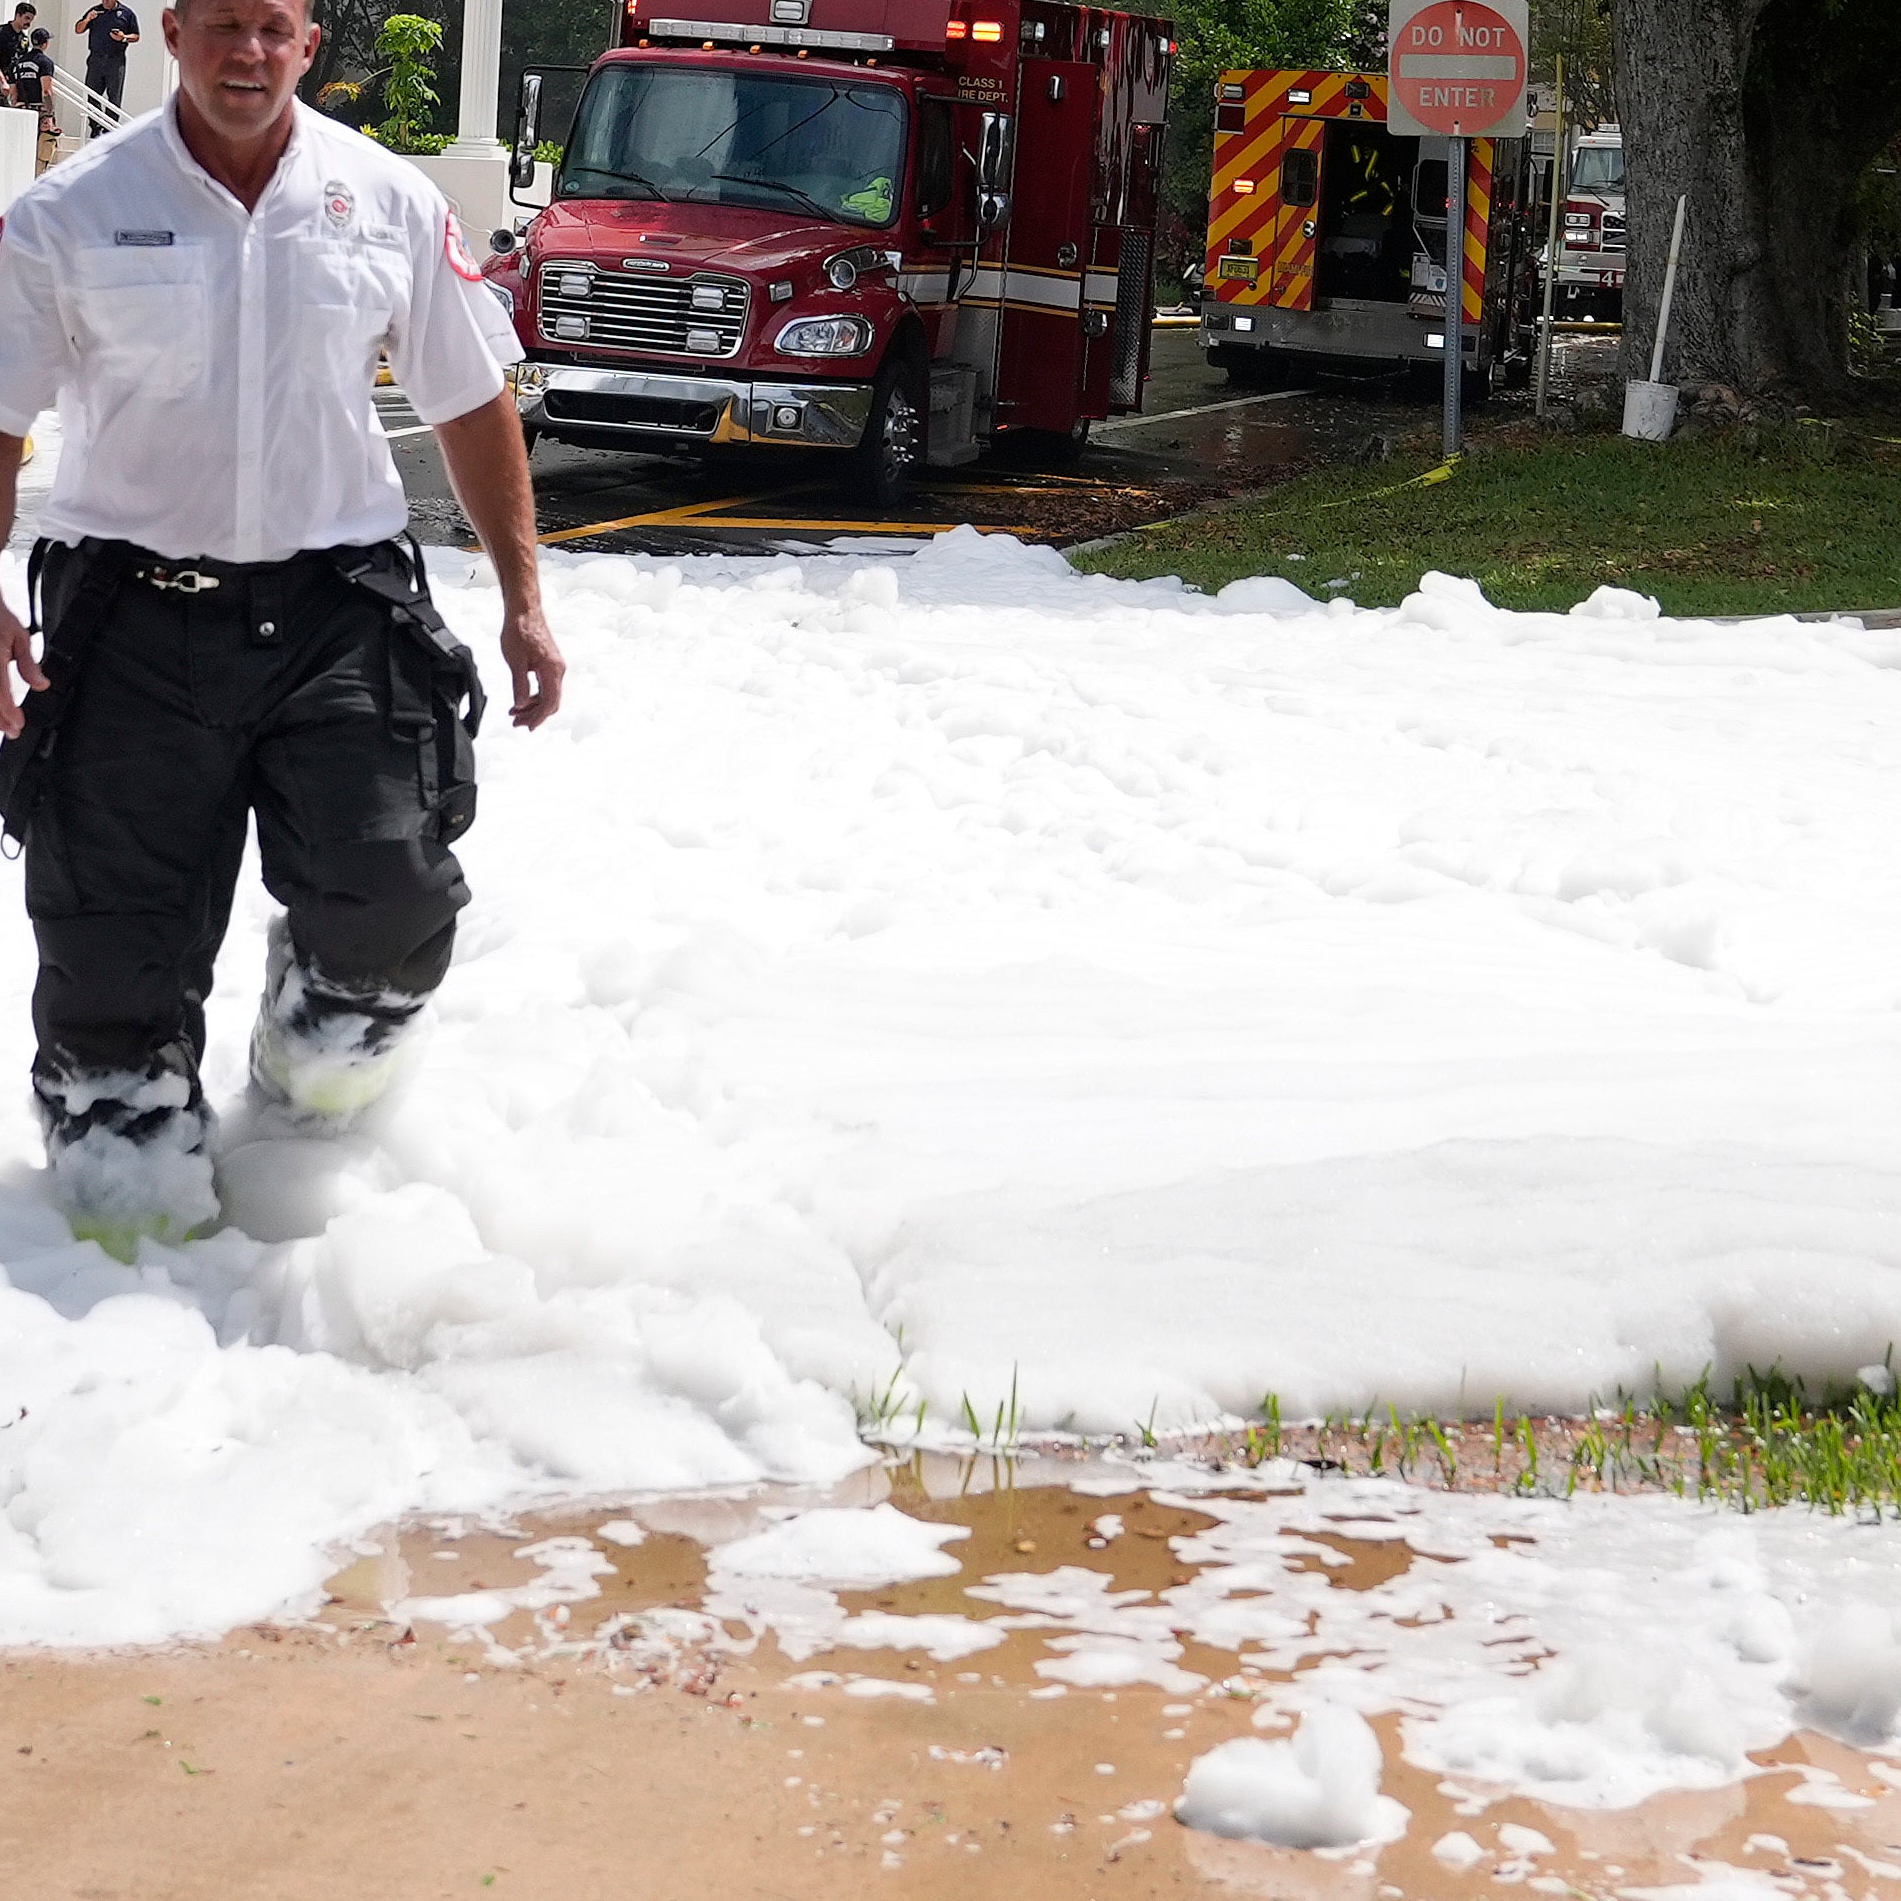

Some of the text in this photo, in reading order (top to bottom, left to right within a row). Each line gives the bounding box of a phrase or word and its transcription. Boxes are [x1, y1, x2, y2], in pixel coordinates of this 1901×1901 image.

[1411, 26, 1506, 48] DO NOT
[958, 76, 996, 89] CLASS
[958, 88, 1009, 103] IRE DEPT.
[1419, 86, 1496, 108] ENTER
[1601, 270, 1615, 288] 4
